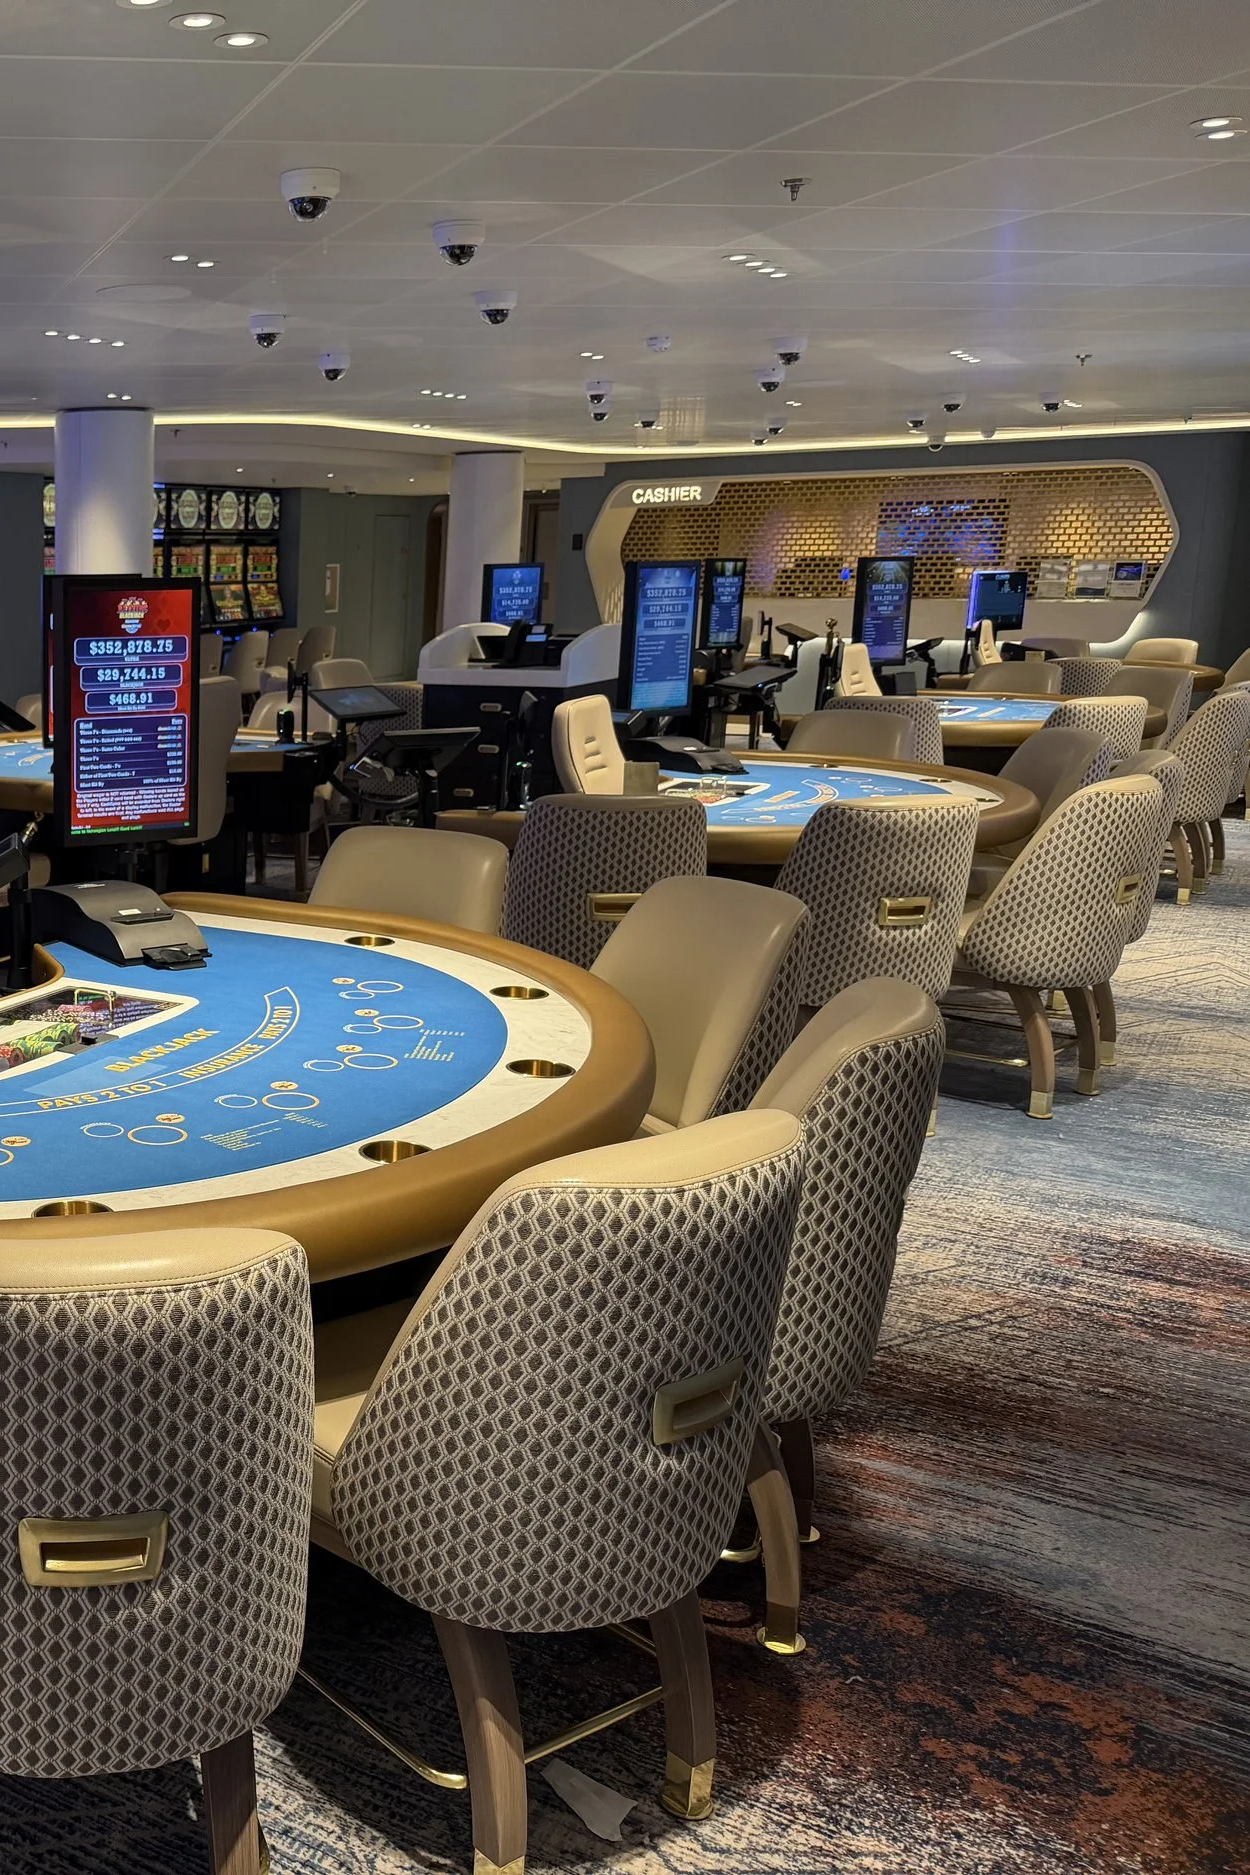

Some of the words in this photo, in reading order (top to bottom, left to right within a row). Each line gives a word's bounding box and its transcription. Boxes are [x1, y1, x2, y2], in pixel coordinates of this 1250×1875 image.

[631, 485, 702, 505] CASHIER
[89, 639, 174, 656] $352,878.75
[97, 667, 166, 682] $29,744.15
[109, 692, 153, 705] $468.91
[257, 1024, 287, 1040] PAYS
[104, 1028, 221, 1073] BLACKJACK
[178, 1042, 266, 1079] INSURANCE
[37, 1094, 100, 1110] PAYS
[100, 1089, 121, 1100] 2
[118, 1084, 152, 1096] TO
[149, 1080, 167, 1088] 1
